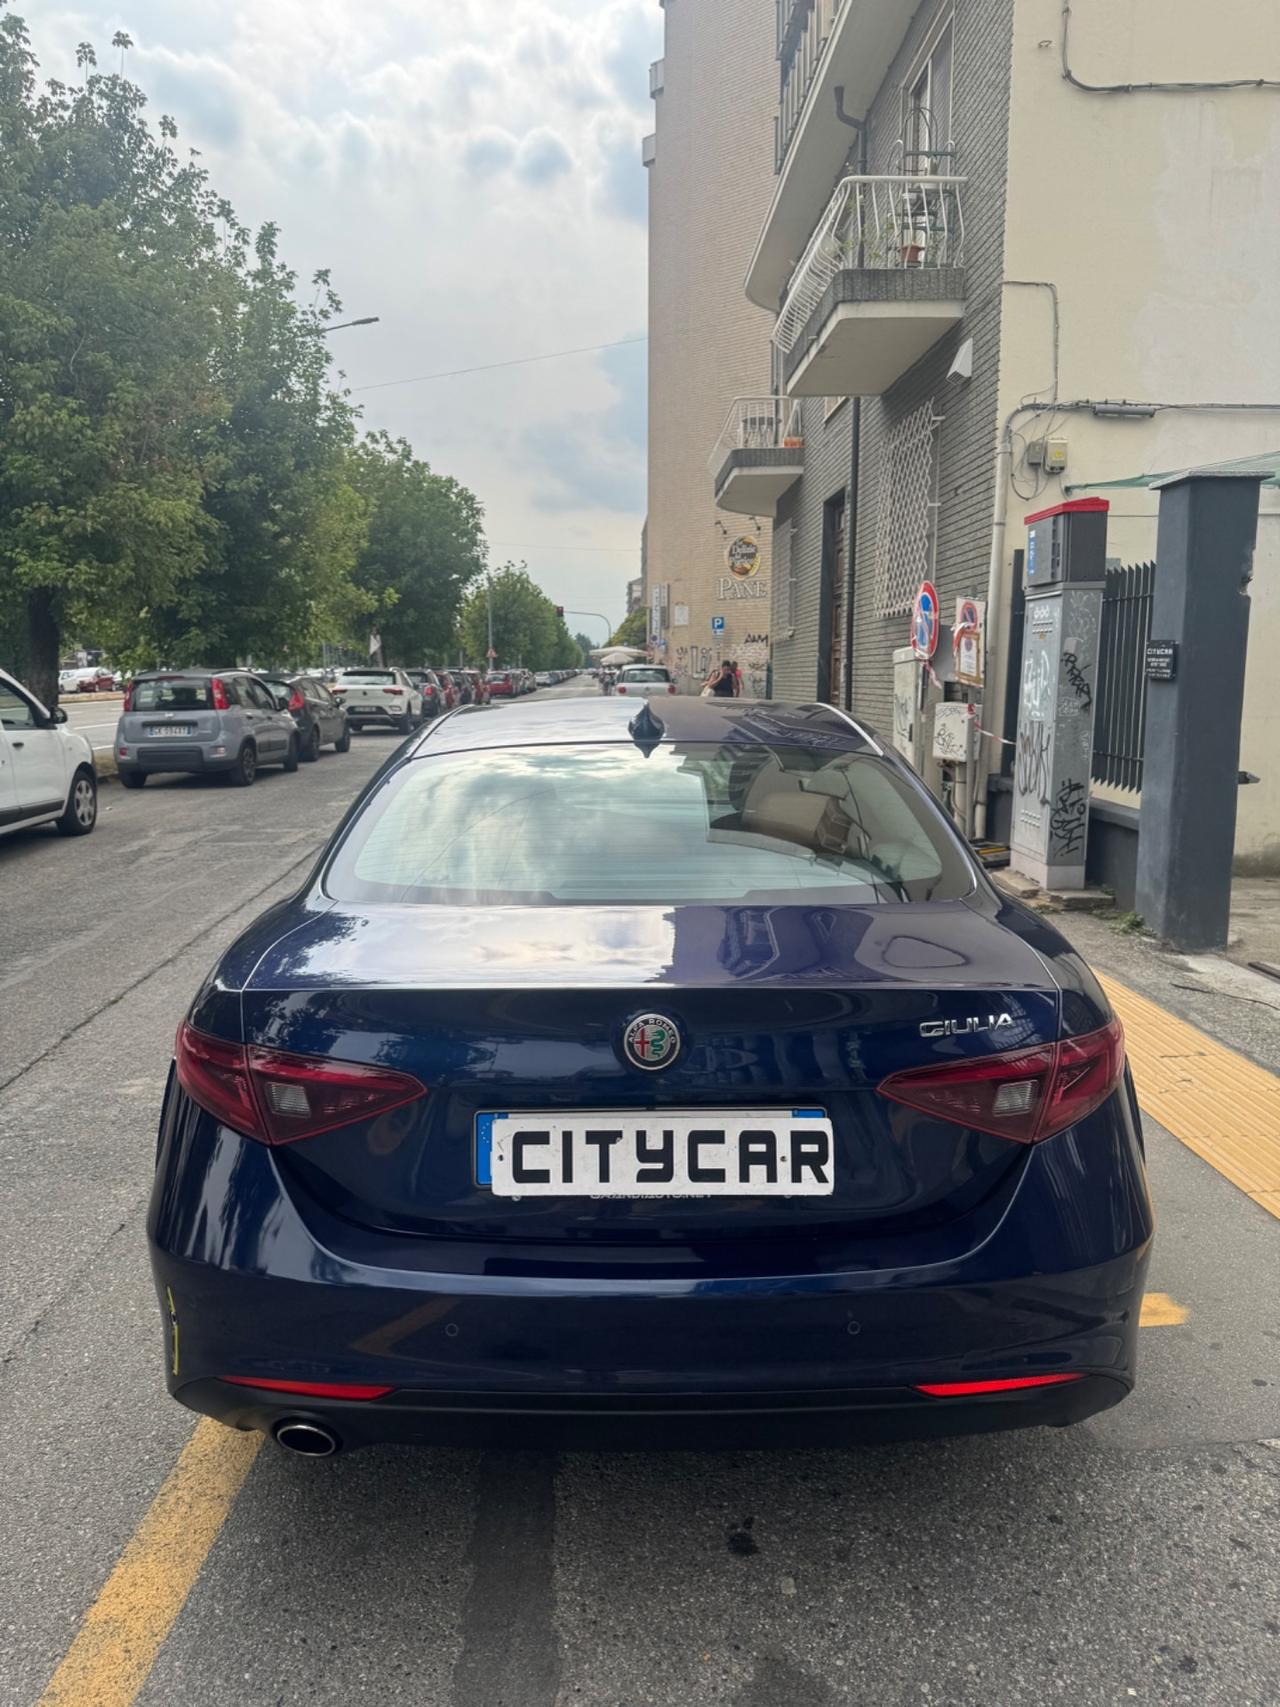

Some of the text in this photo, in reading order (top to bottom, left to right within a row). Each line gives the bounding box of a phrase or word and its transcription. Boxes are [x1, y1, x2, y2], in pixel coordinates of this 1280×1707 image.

[719, 577, 767, 599] PANE
[919, 1012, 1013, 1038] GIULIA
[511, 1129, 830, 1184] CITYCAR
